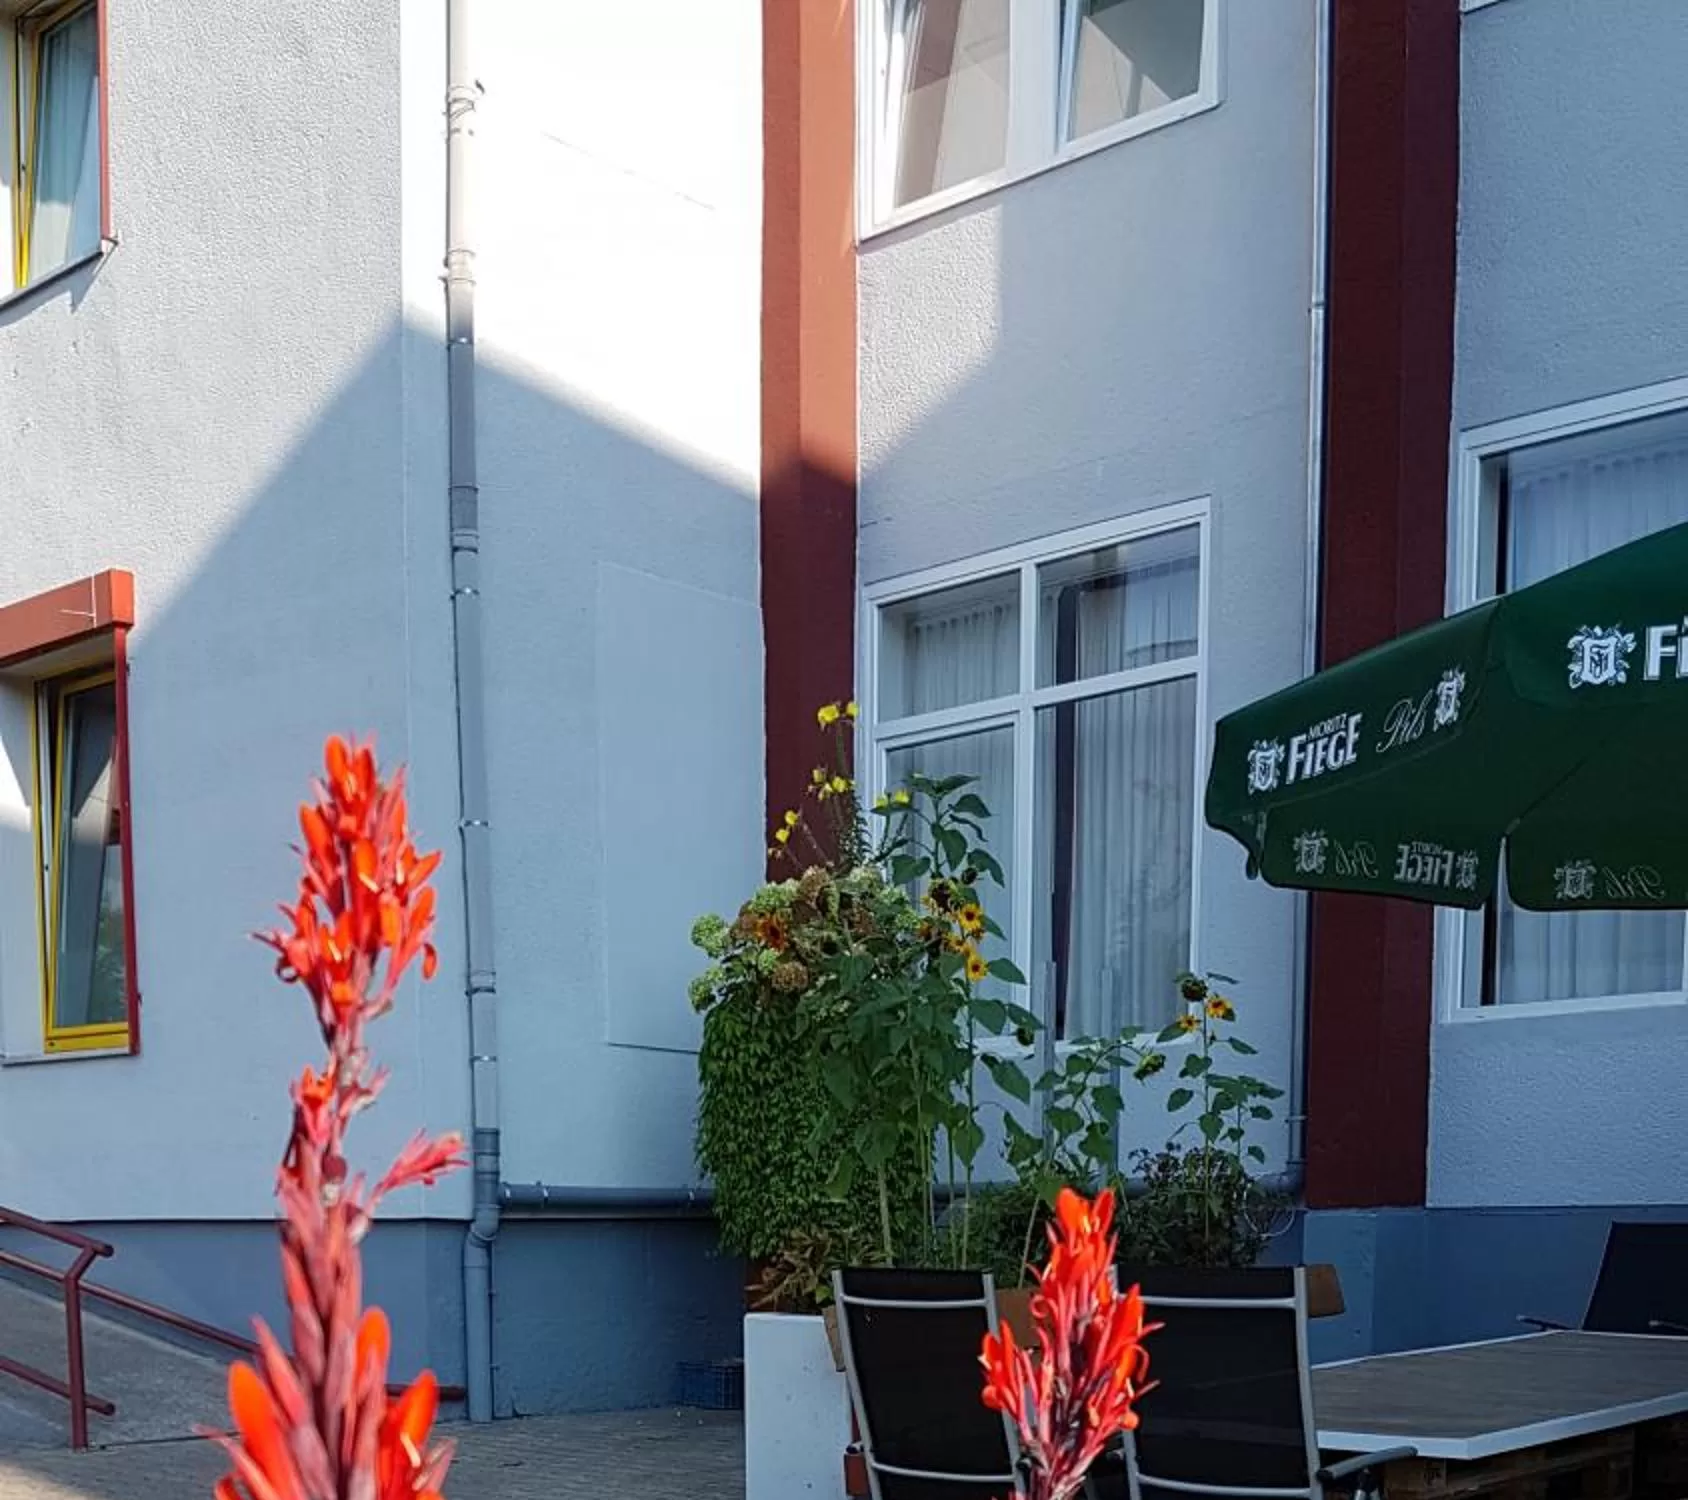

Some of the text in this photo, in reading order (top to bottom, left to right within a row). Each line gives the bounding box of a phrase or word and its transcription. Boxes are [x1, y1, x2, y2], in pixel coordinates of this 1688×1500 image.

[1285, 689, 1433, 785] FIEGE Pils
[1308, 712, 1347, 740] MORITZ
